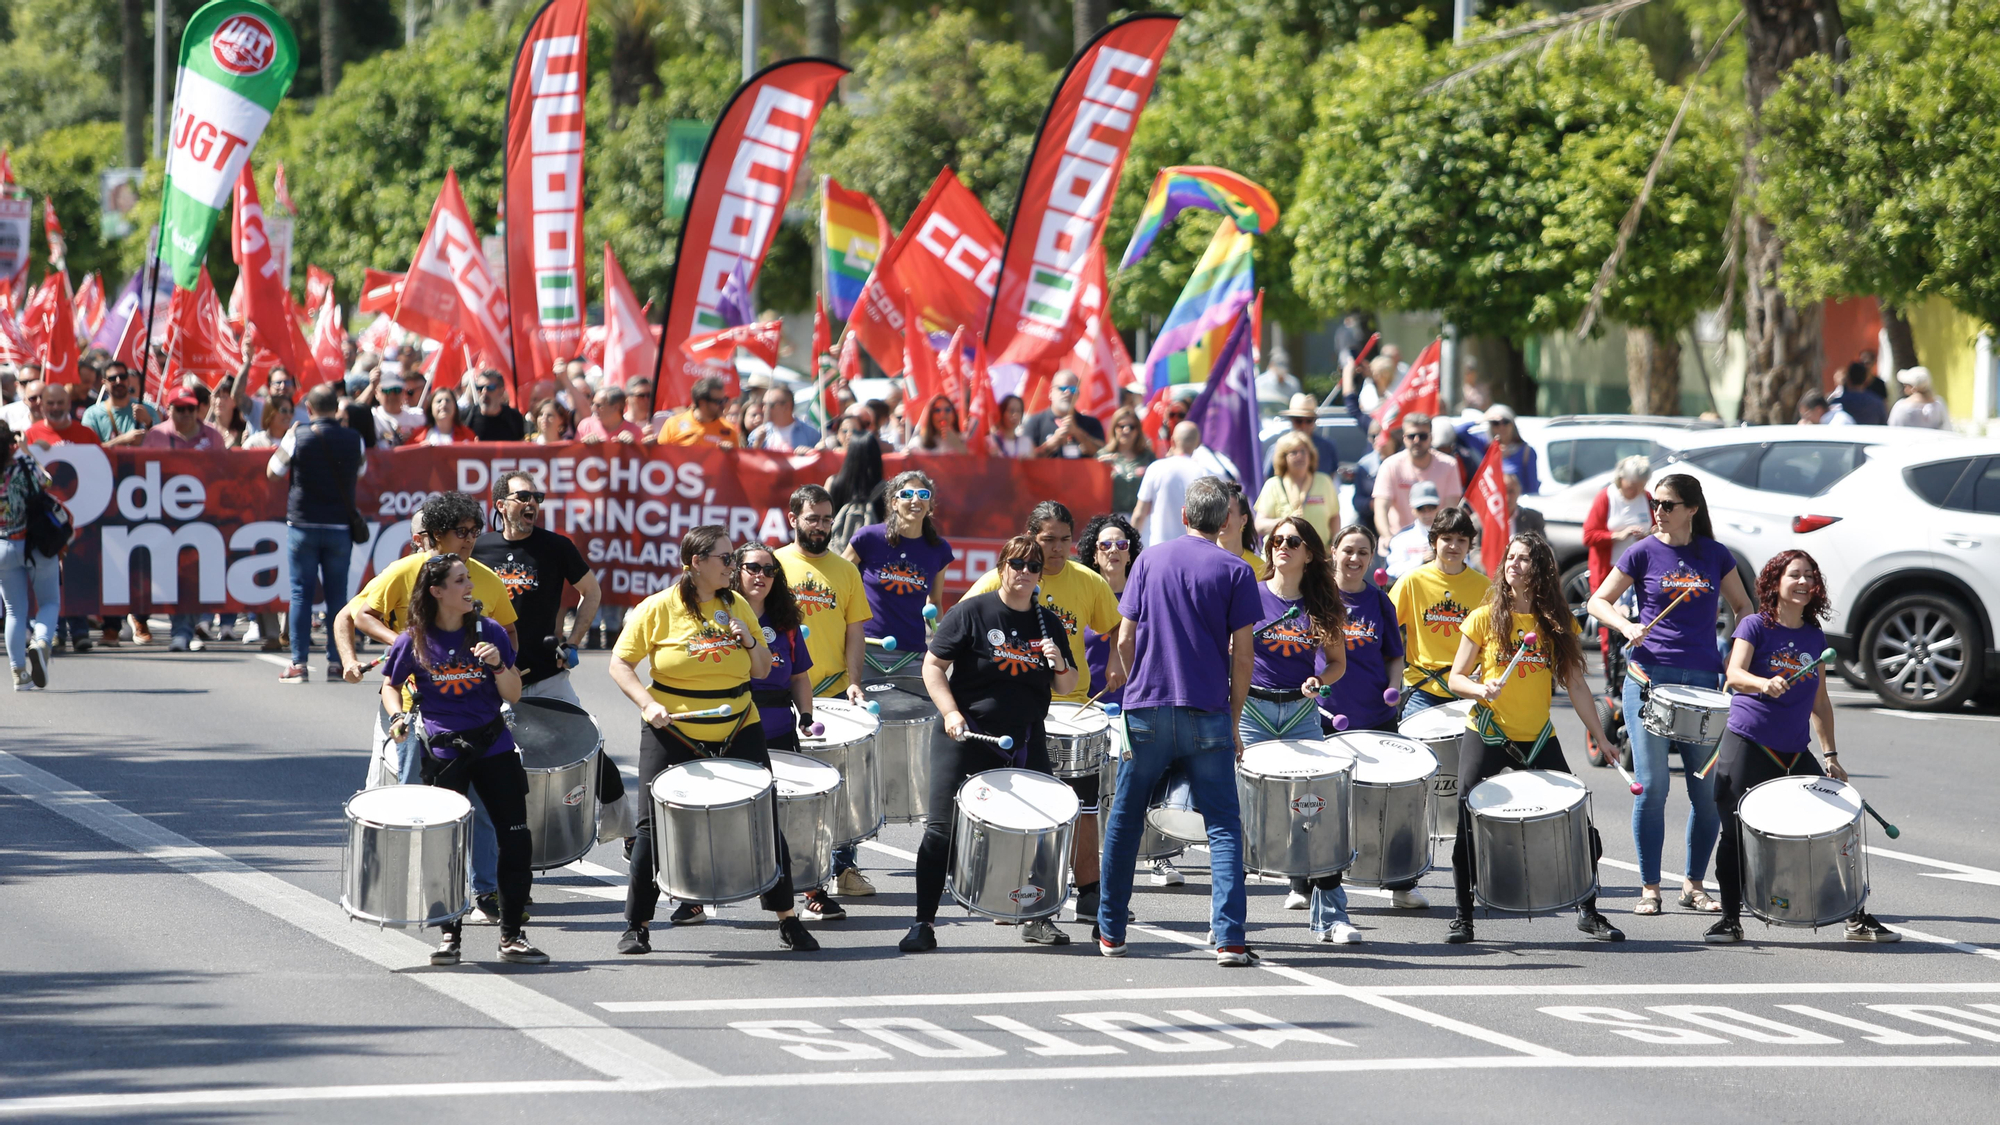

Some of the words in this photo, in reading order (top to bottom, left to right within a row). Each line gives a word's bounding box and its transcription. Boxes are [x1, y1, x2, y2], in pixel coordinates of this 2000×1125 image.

[220, 18, 273, 60] UGT
[173, 107, 248, 172] UGT
[117, 461, 206, 521] de
[880, 571, 925, 586] SAMBOREJO
[432, 671, 483, 682] SAMBOREJO
[994, 649, 1039, 663] SAMBOREJO
[1813, 784, 1840, 797] LUEN
[727, 1008, 1358, 1062] MOTOS
[1535, 1003, 2000, 1046] OTOS
